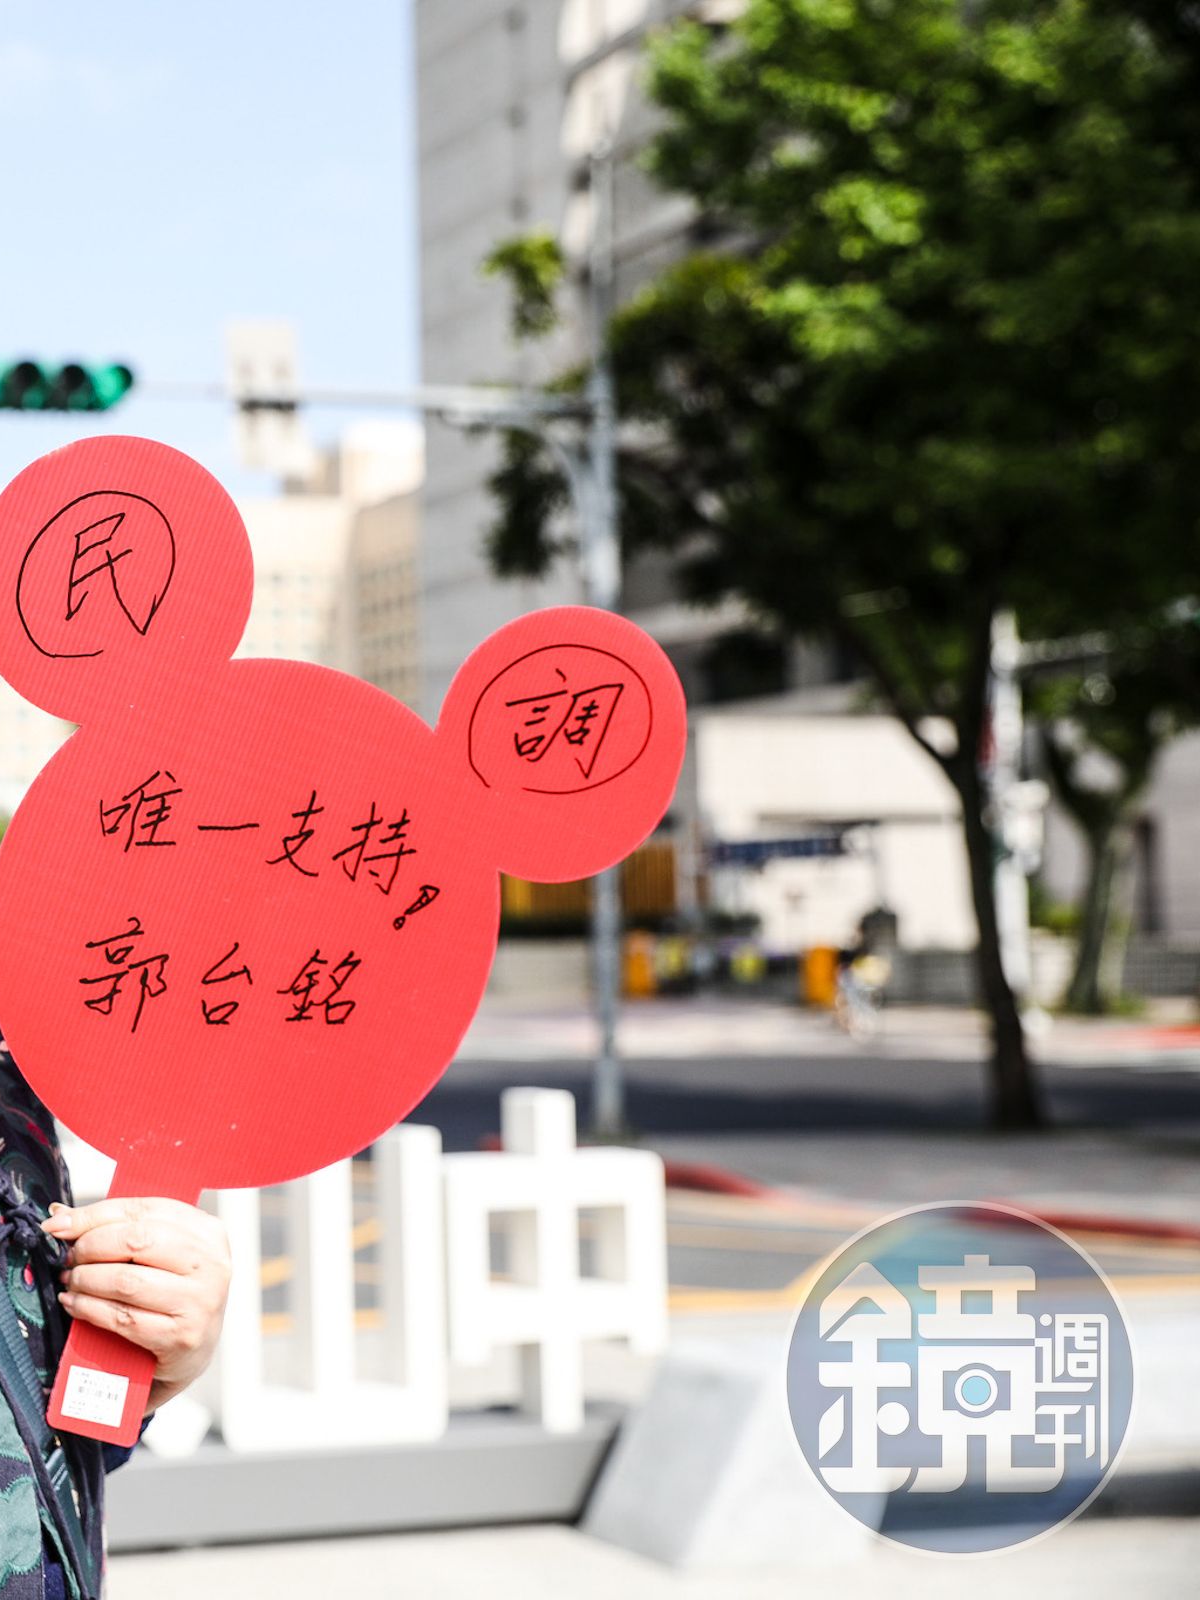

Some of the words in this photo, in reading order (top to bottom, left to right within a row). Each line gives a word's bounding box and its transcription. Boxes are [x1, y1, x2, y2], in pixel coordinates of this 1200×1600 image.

[66, 512, 147, 636] 民
[504, 668, 625, 779] 調
[80, 917, 361, 1032] 郭台銘
